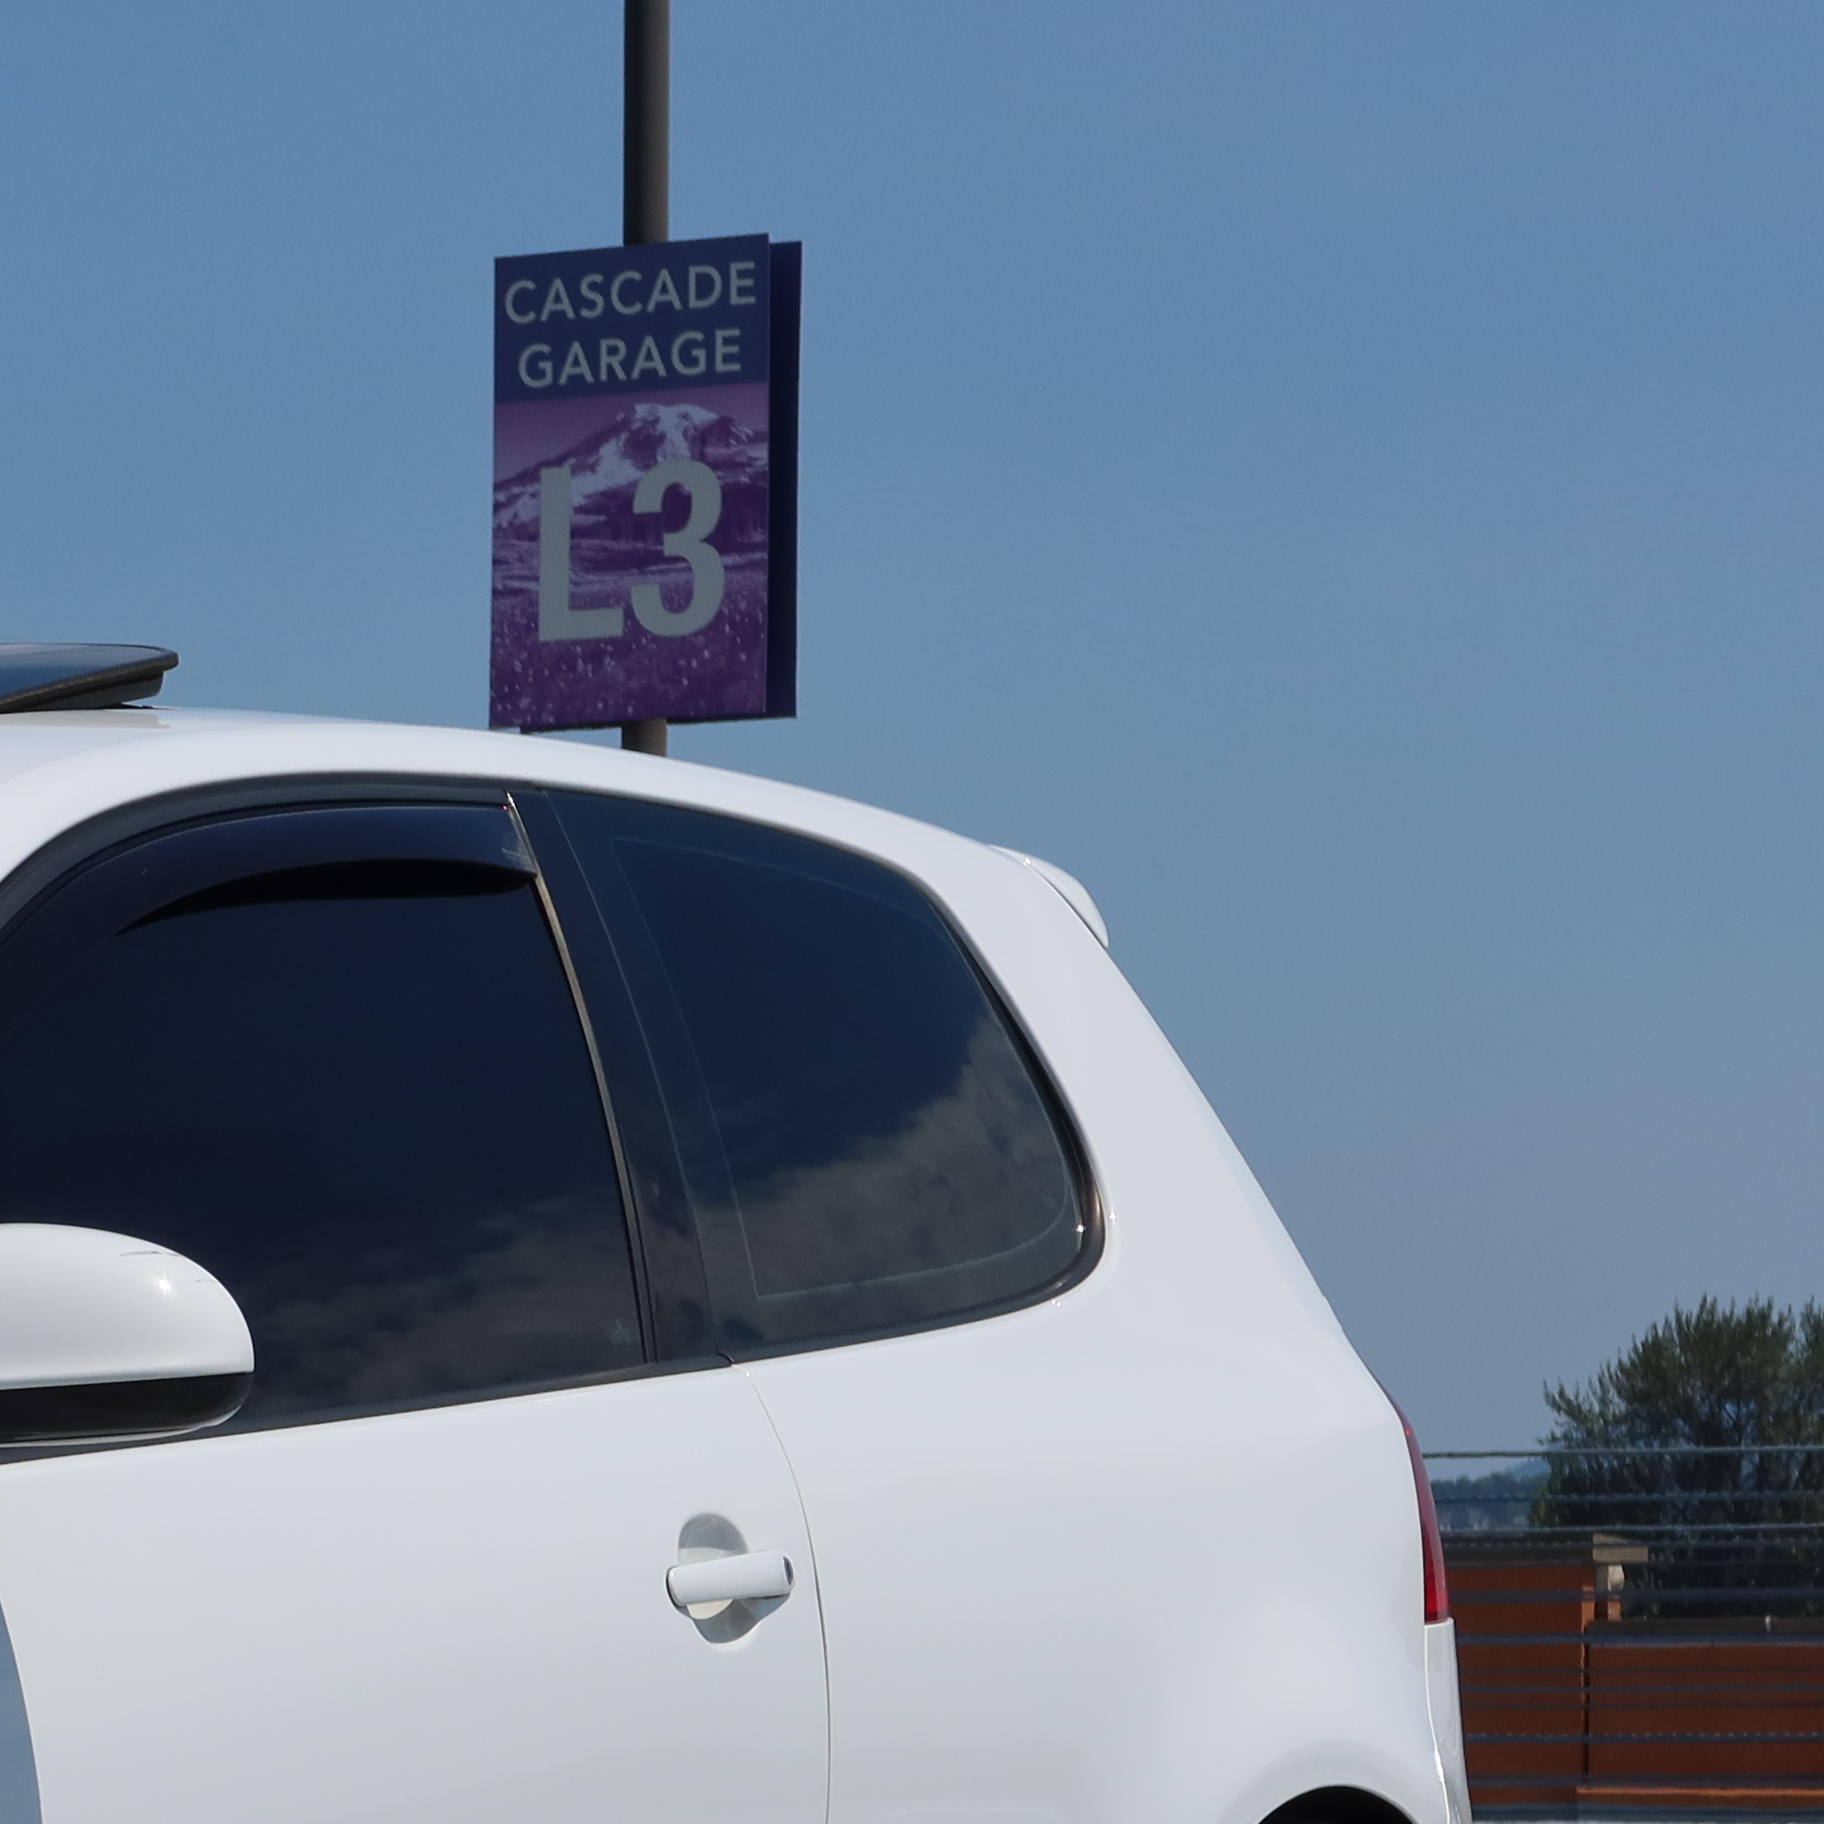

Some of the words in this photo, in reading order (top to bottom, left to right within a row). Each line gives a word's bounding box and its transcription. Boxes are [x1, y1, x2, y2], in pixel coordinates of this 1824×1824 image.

[503, 261, 757, 325] CASCADE
[517, 328, 742, 388] GARAGE
[538, 459, 726, 642] L3
